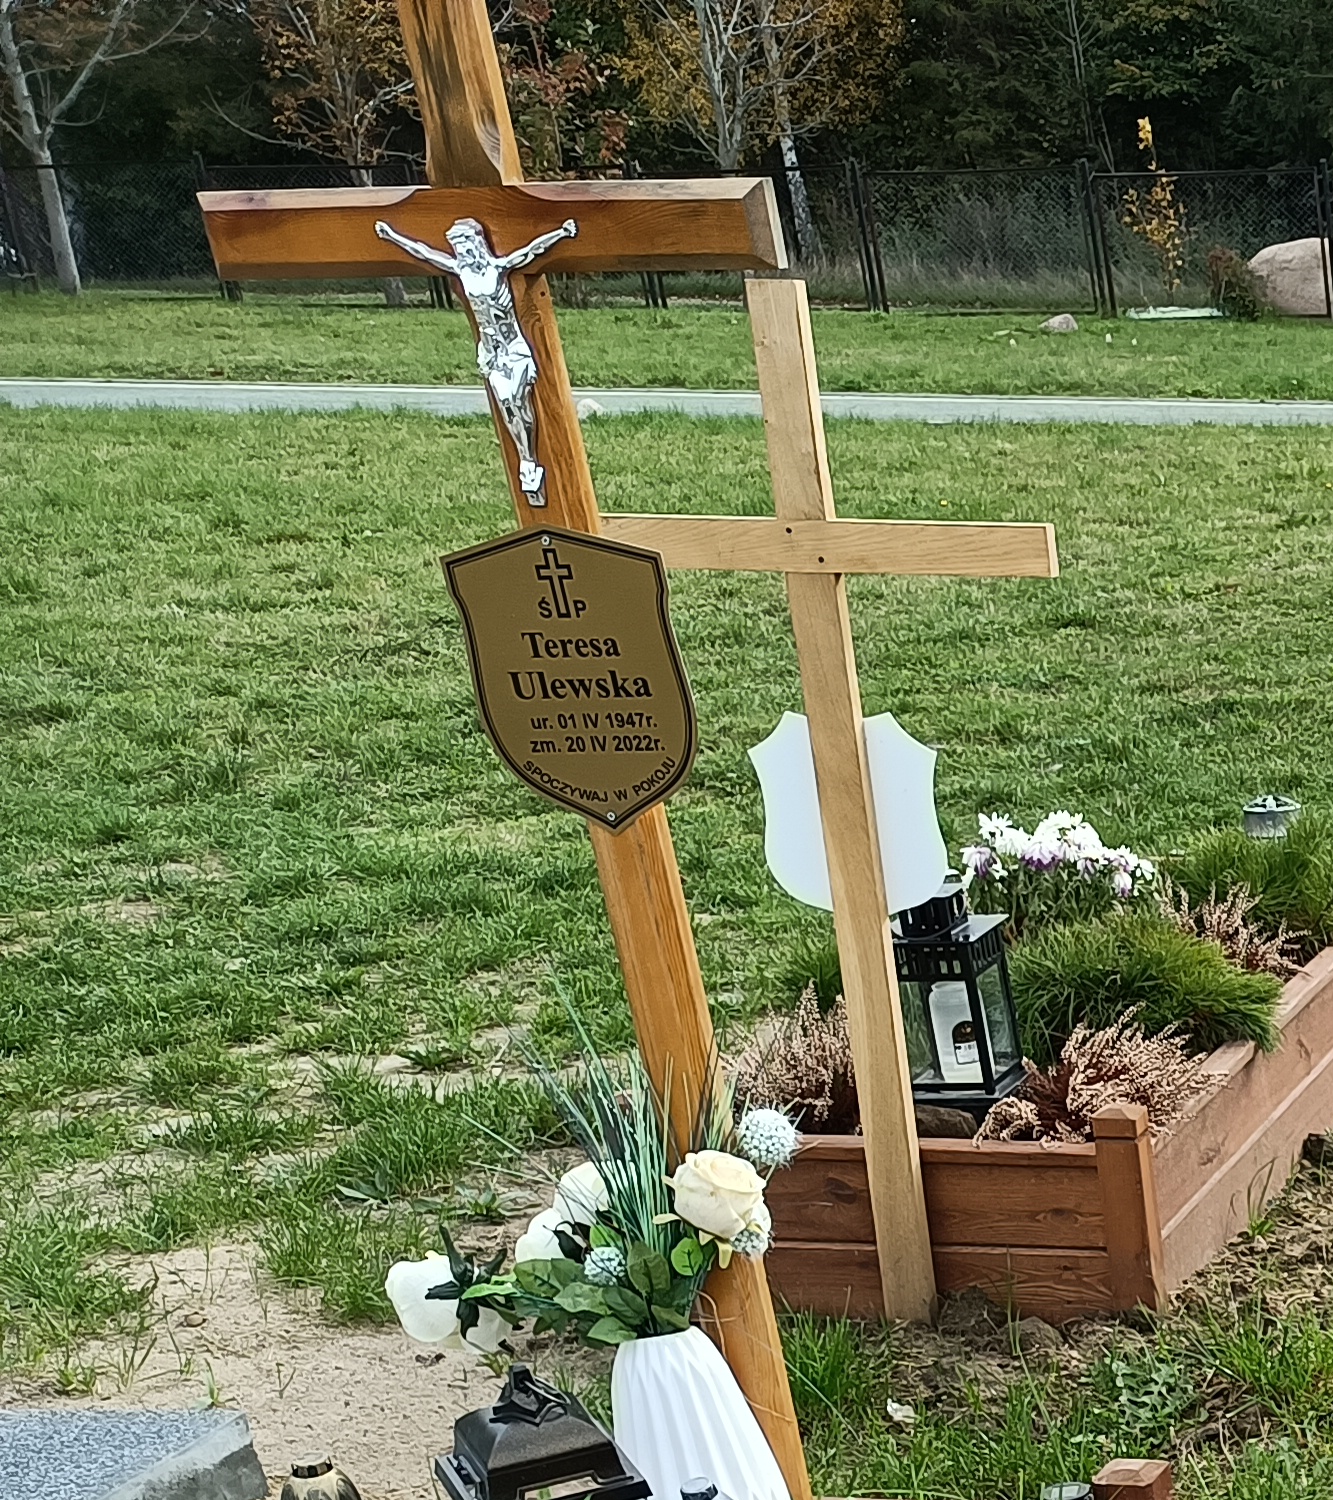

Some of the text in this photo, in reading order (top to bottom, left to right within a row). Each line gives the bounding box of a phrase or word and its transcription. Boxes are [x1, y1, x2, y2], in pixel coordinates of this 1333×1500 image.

[538, 596, 587, 618] Ś P
[521, 631, 621, 659] Teresa
[508, 669, 653, 700] Ulewska
[530, 712, 658, 730] ur. 01 IV 1947r.
[530, 734, 666, 753] zm. 20 IV 2022r.
[523, 756, 676, 803] SPOCZYWAJ W POKOJU
